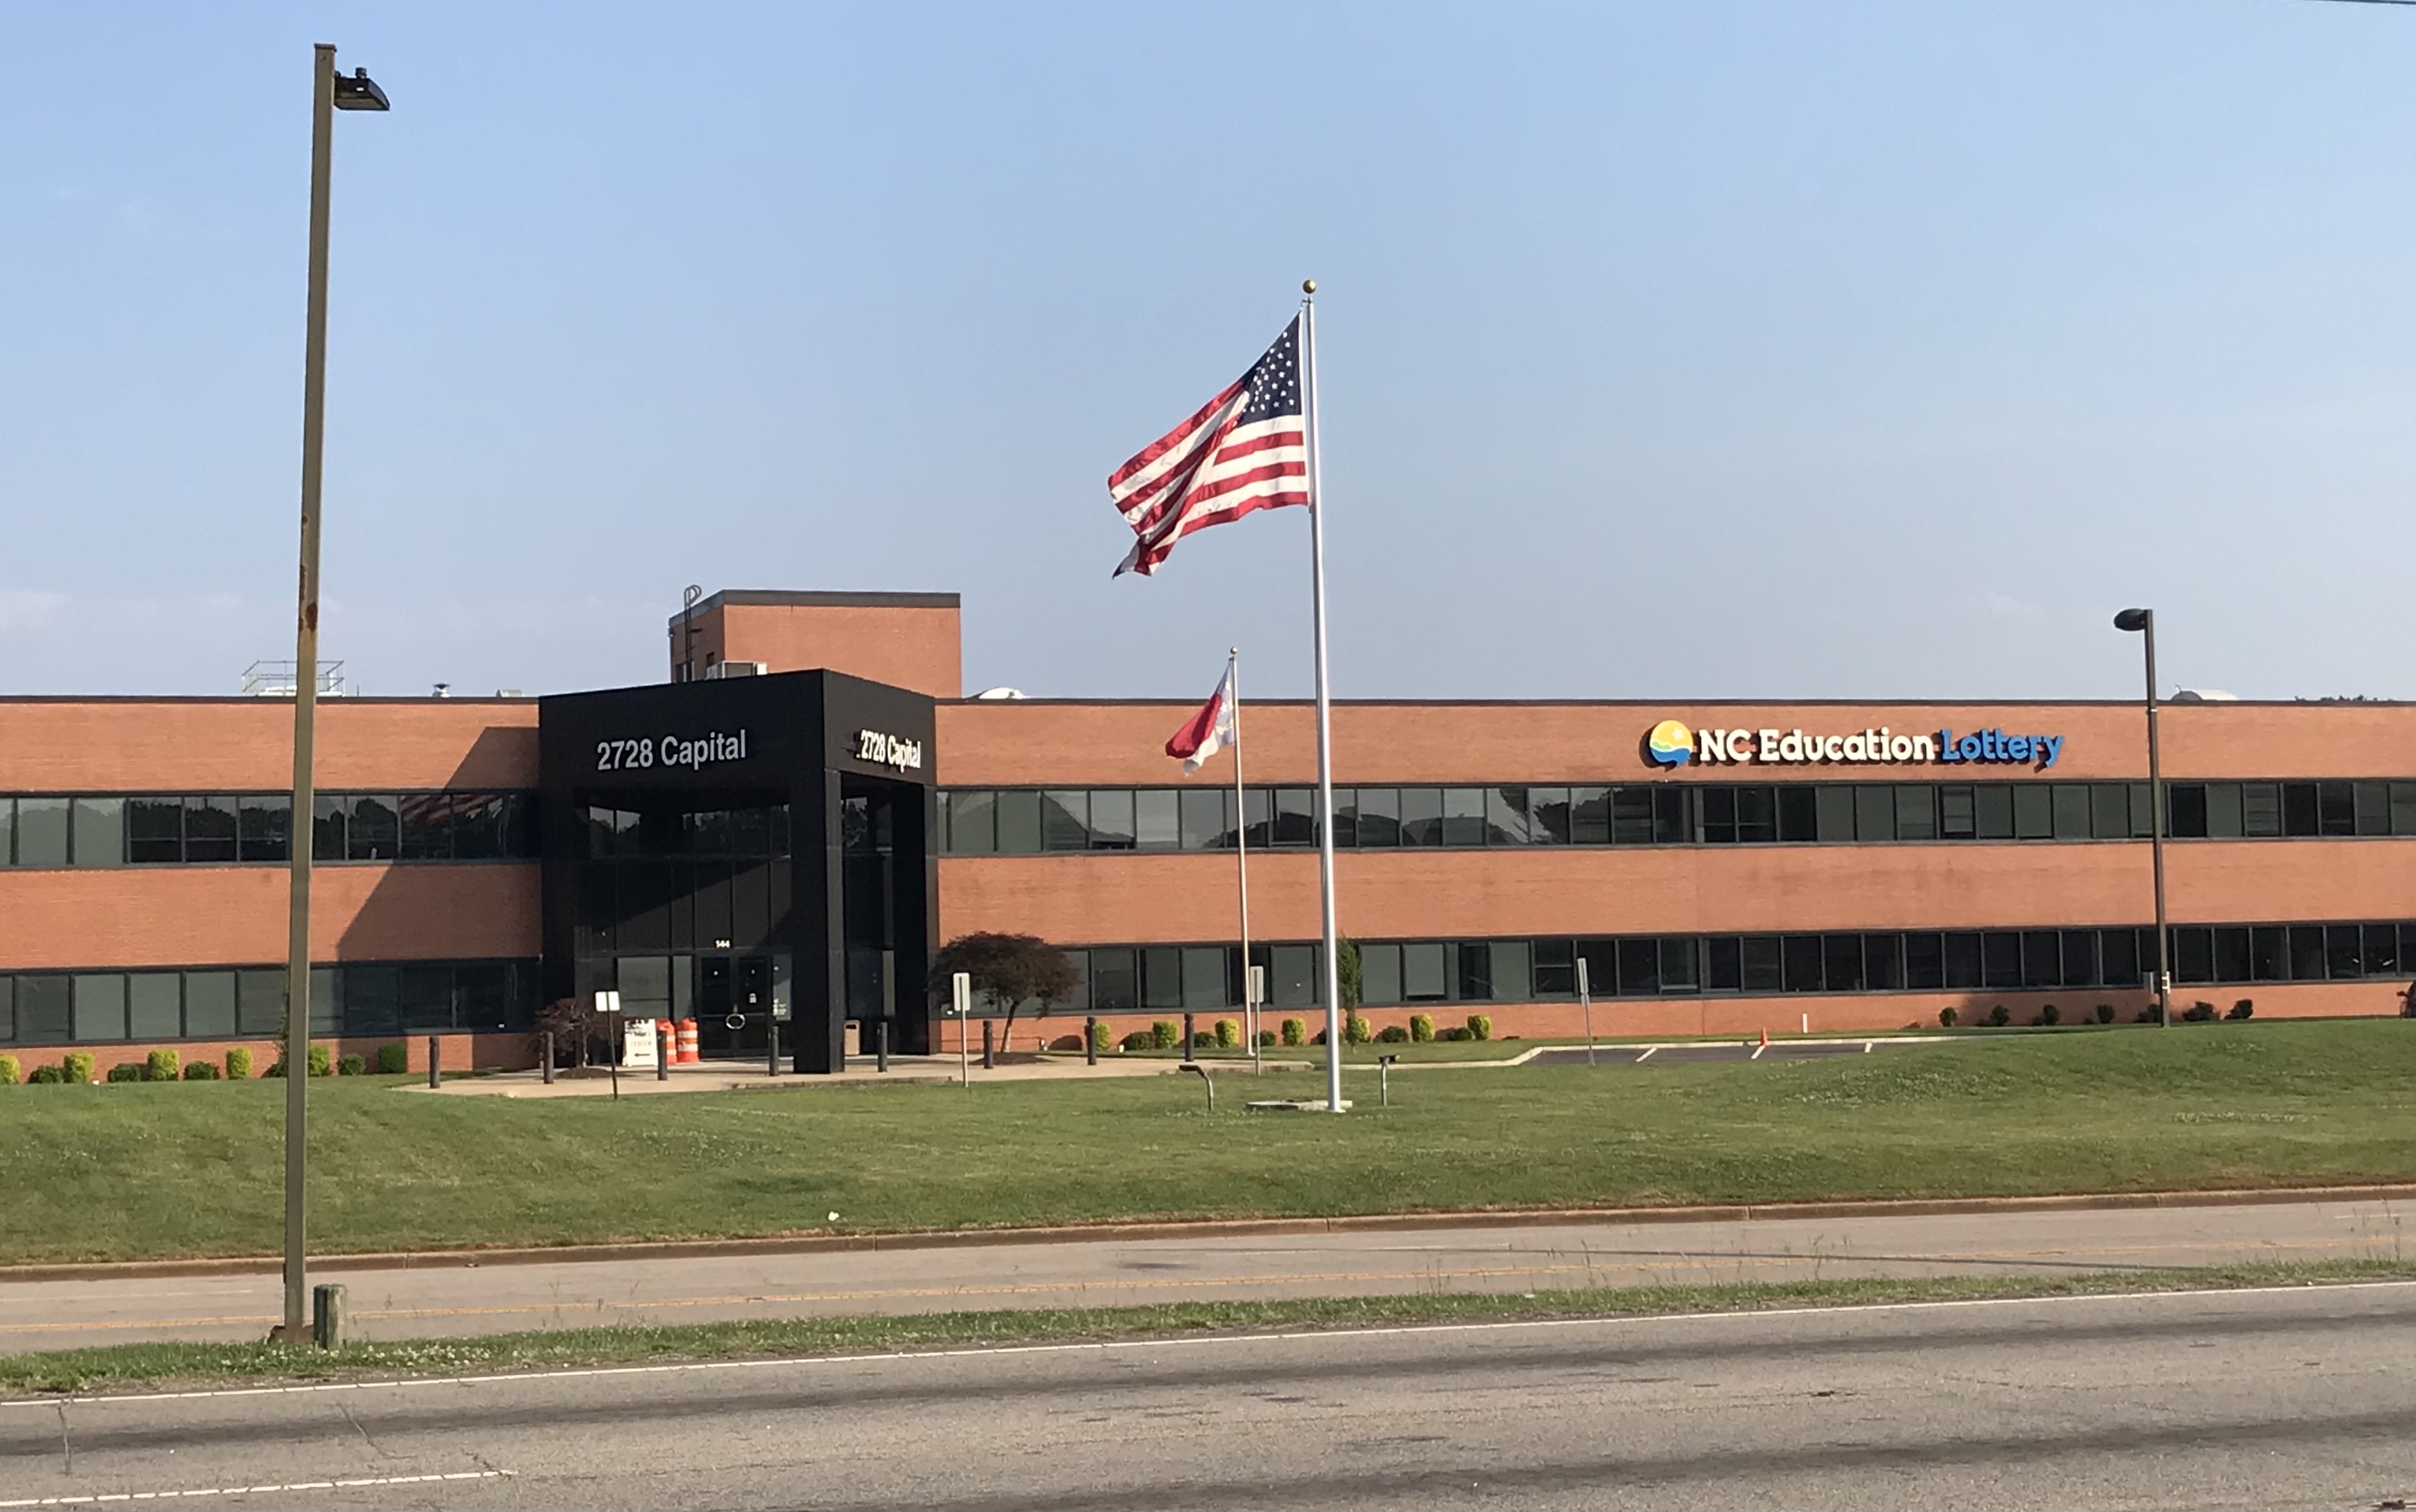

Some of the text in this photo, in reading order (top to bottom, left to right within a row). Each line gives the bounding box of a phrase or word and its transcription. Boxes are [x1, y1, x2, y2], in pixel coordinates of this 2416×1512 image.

[597, 729, 746, 770] 2728 Capital
[860, 729, 921, 773] 2728 Capital
[1699, 726, 2065, 768] NC Education Lottery
[715, 939, 730, 948] 144
